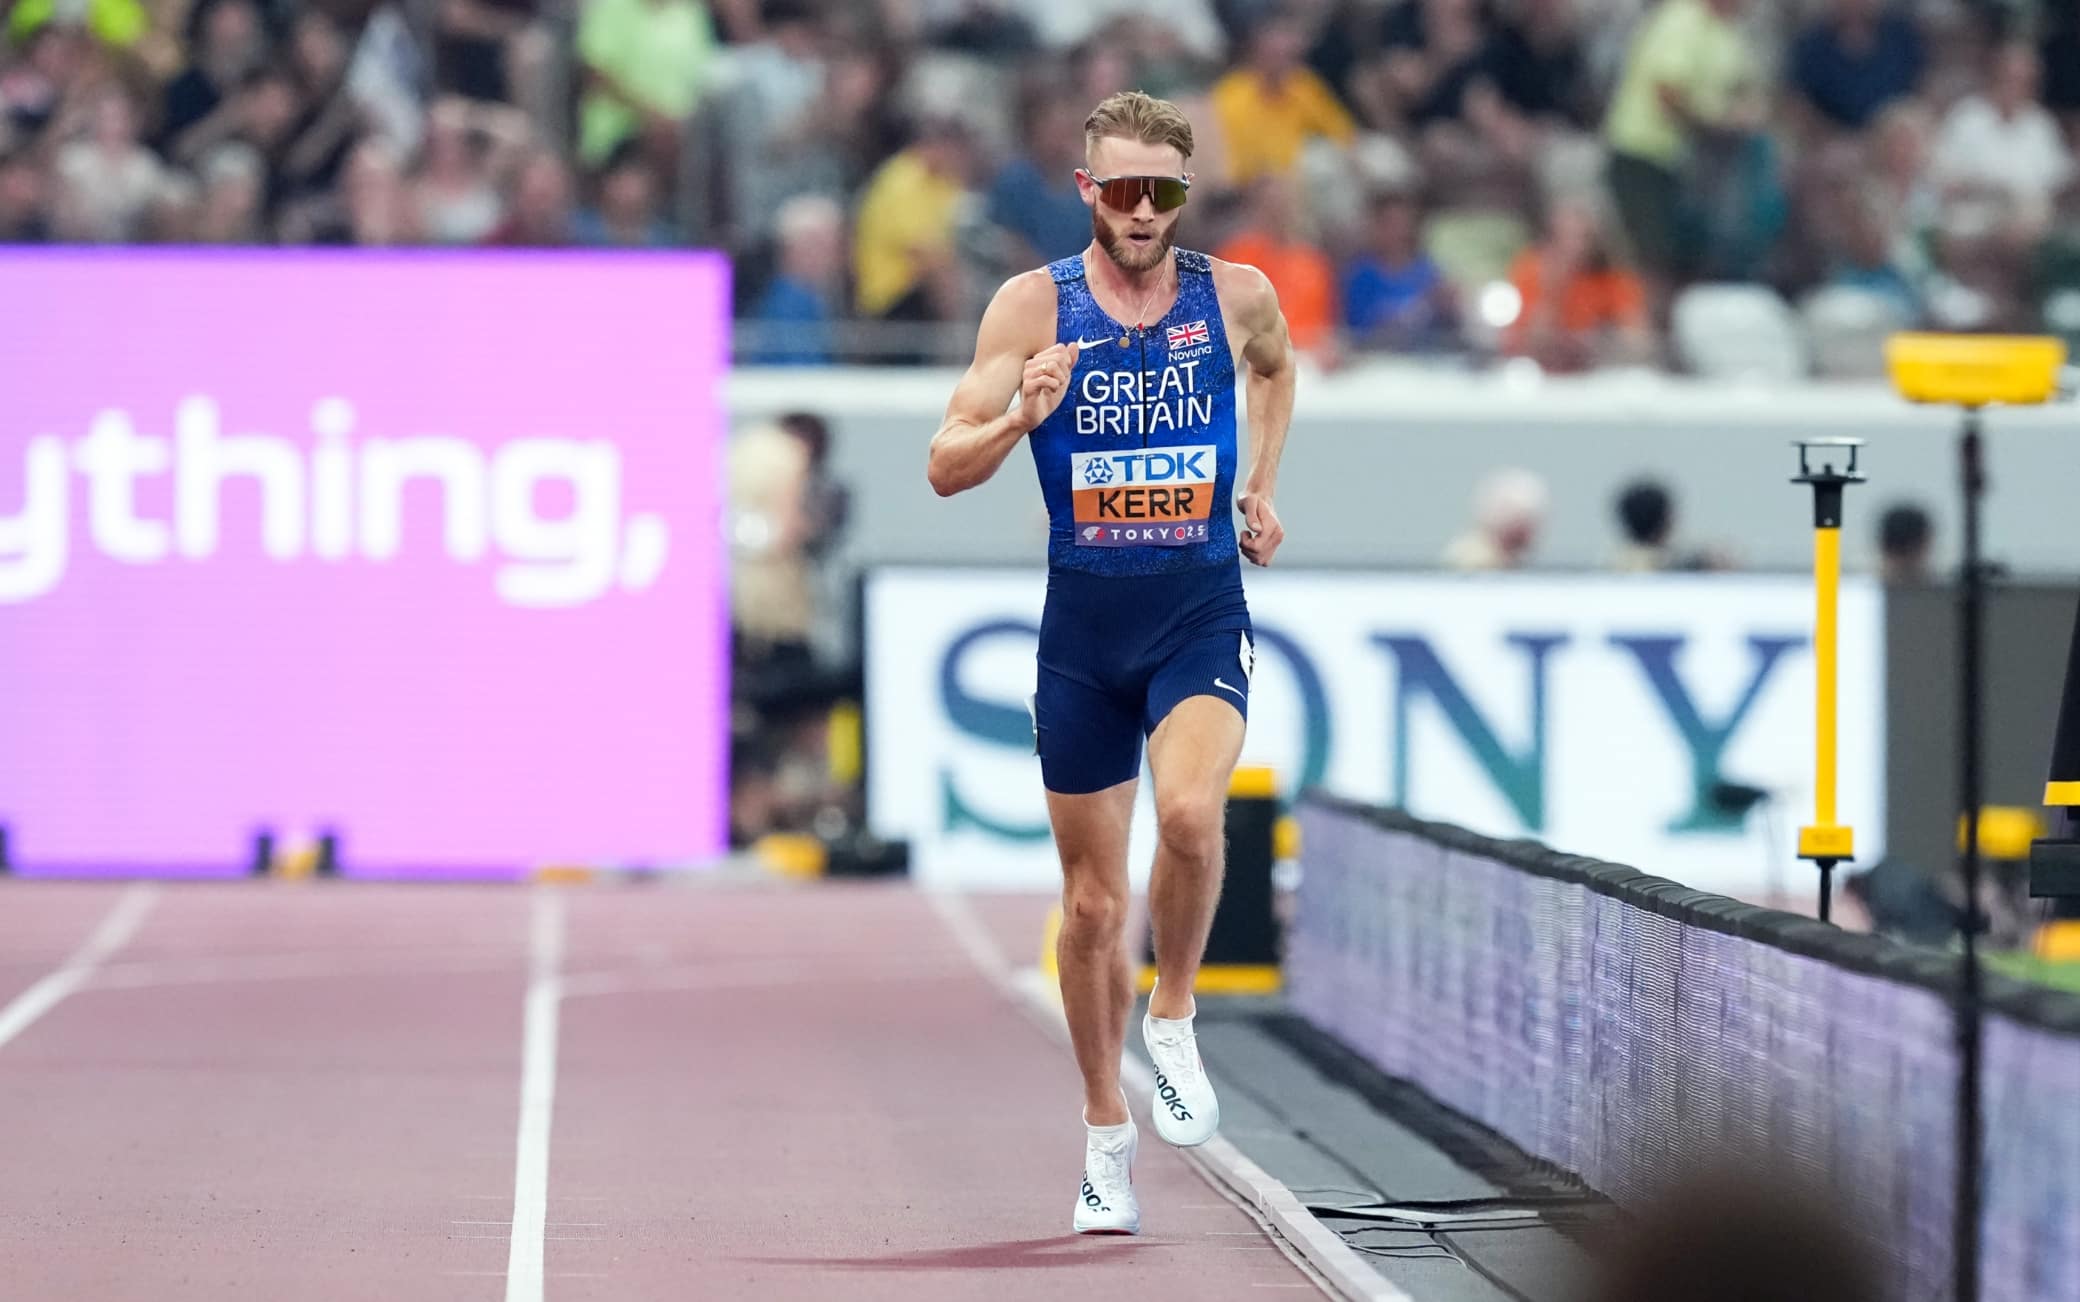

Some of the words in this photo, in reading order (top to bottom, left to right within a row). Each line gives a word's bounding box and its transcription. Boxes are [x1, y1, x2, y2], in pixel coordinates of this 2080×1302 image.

[1168, 345, 1212, 363] Novuna
[1083, 361, 1200, 403] GREAT
[1076, 394, 1212, 435] BRITAIN
[1112, 451, 1206, 482] TDK
[1098, 487, 1194, 518] KERR
